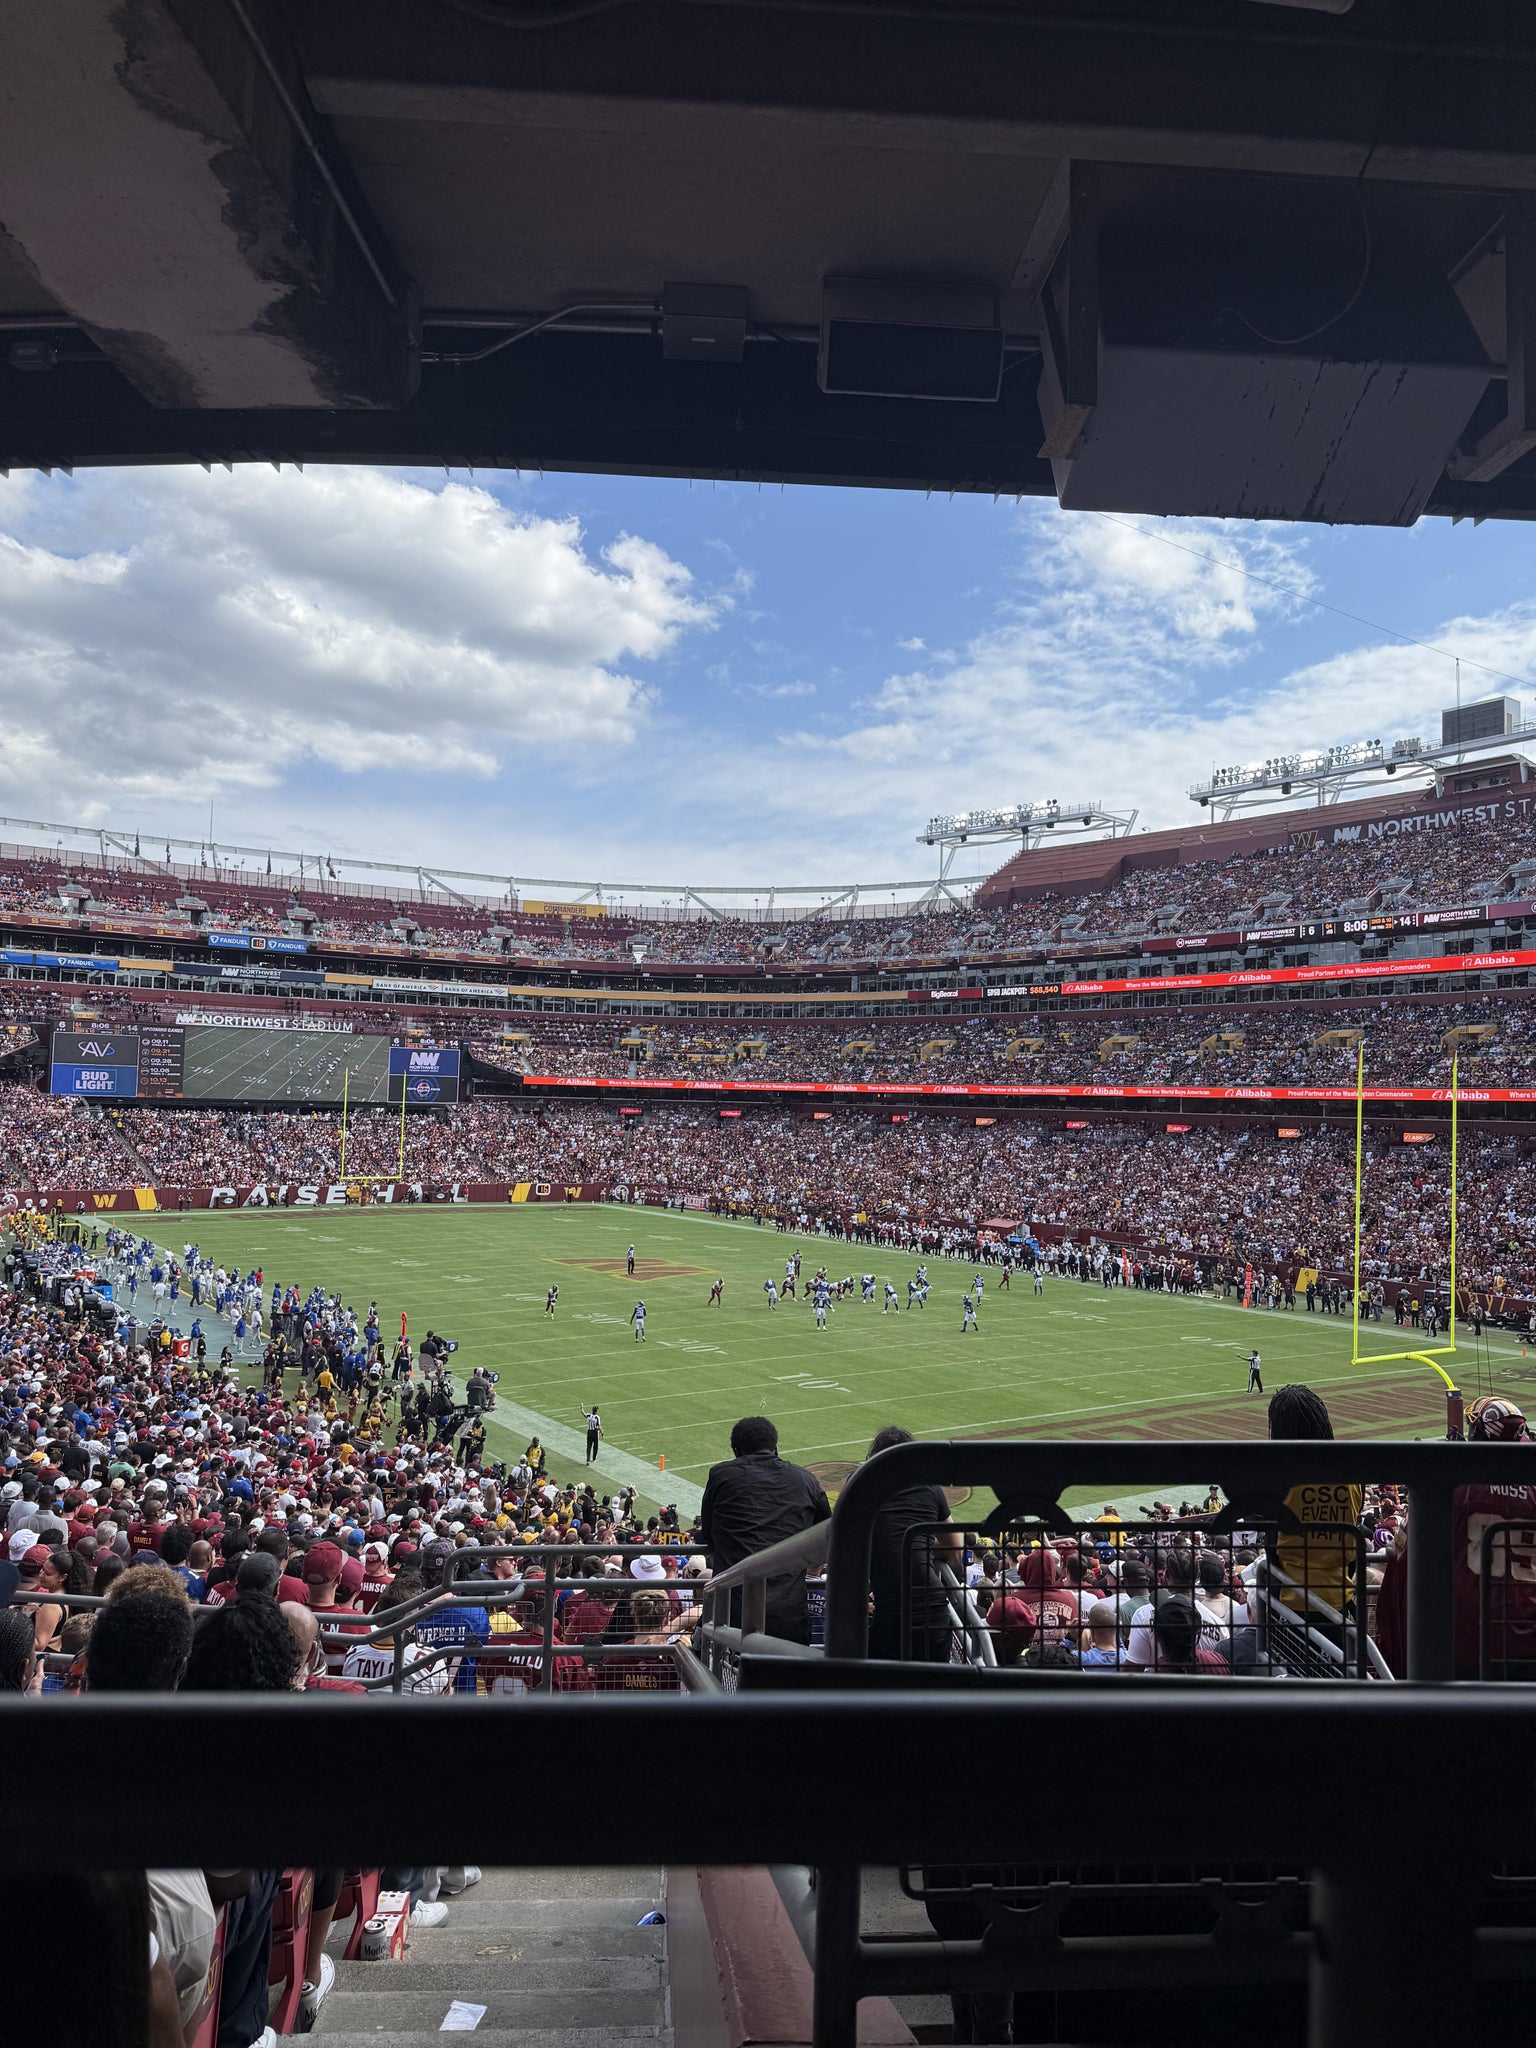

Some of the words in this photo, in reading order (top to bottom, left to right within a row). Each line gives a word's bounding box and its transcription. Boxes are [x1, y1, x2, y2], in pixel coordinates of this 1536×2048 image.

[1368, 803, 1500, 838] NORTHWEST
[543, 905, 587, 914] COMMANDERS
[1440, 908, 1480, 918] NORTHWEST
[1344, 920, 1368, 932] 8:06
[1400, 916, 1411, 927] 14
[1260, 928, 1296, 937] NORTHWEST
[1308, 926, 1314, 935] 6
[220, 937, 248, 946] FANDUEL
[277, 942, 306, 950] FANDUEL
[1474, 955, 1515, 966] Alibaba
[240, 968, 282, 976] NORTHWEST
[1298, 970, 1314, 978] Proud
[1355, 966, 1390, 975] Washington
[1390, 963, 1431, 972] Commanders
[1178, 978, 1202, 986] American
[1238, 974, 1272, 982] Alibaba
[126, 1024, 138, 1032] 14
[201, 1015, 290, 1028] NORTHWEST
[292, 1020, 352, 1032] STADIUM
[410, 1052, 440, 1066] NW
[81, 1071, 110, 1080] BUD
[75, 1080, 114, 1090] LIGHT
[566, 1078, 596, 1086] Alibaba
[832, 1084, 858, 1092] Alibaba
[1236, 1090, 1272, 1098] Alibaba
[1342, 1090, 1374, 1098] Washgton
[1445, 1090, 1490, 1099] Aibaba
[181, 1342, 189, 1352] G
[1301, 1486, 1349, 1504] CSC
[1490, 1485, 1528, 1500] MOSS
[1302, 1506, 1349, 1522] EVENT
[133, 1536, 152, 1545] DANIELS
[206, 1588, 226, 1607] TAYLO
[418, 1626, 455, 1642] WRENCE
[626, 1674, 658, 1688] DANIELS
